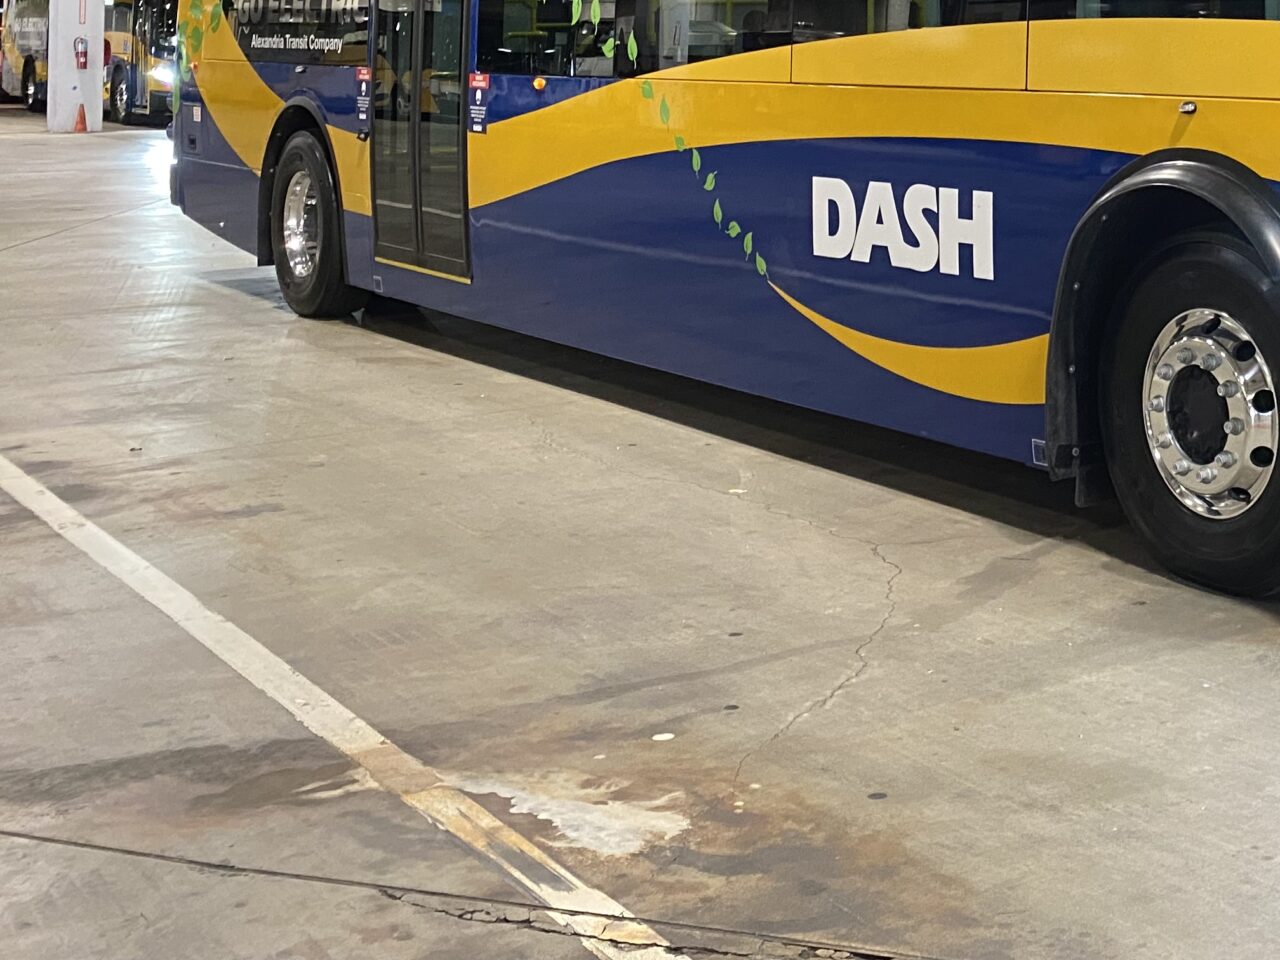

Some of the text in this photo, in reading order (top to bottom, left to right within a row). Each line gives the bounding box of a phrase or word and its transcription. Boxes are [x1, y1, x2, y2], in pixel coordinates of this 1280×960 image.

[251, 34, 343, 53] Alexandria Transit Company
[812, 175, 995, 281] DASH
